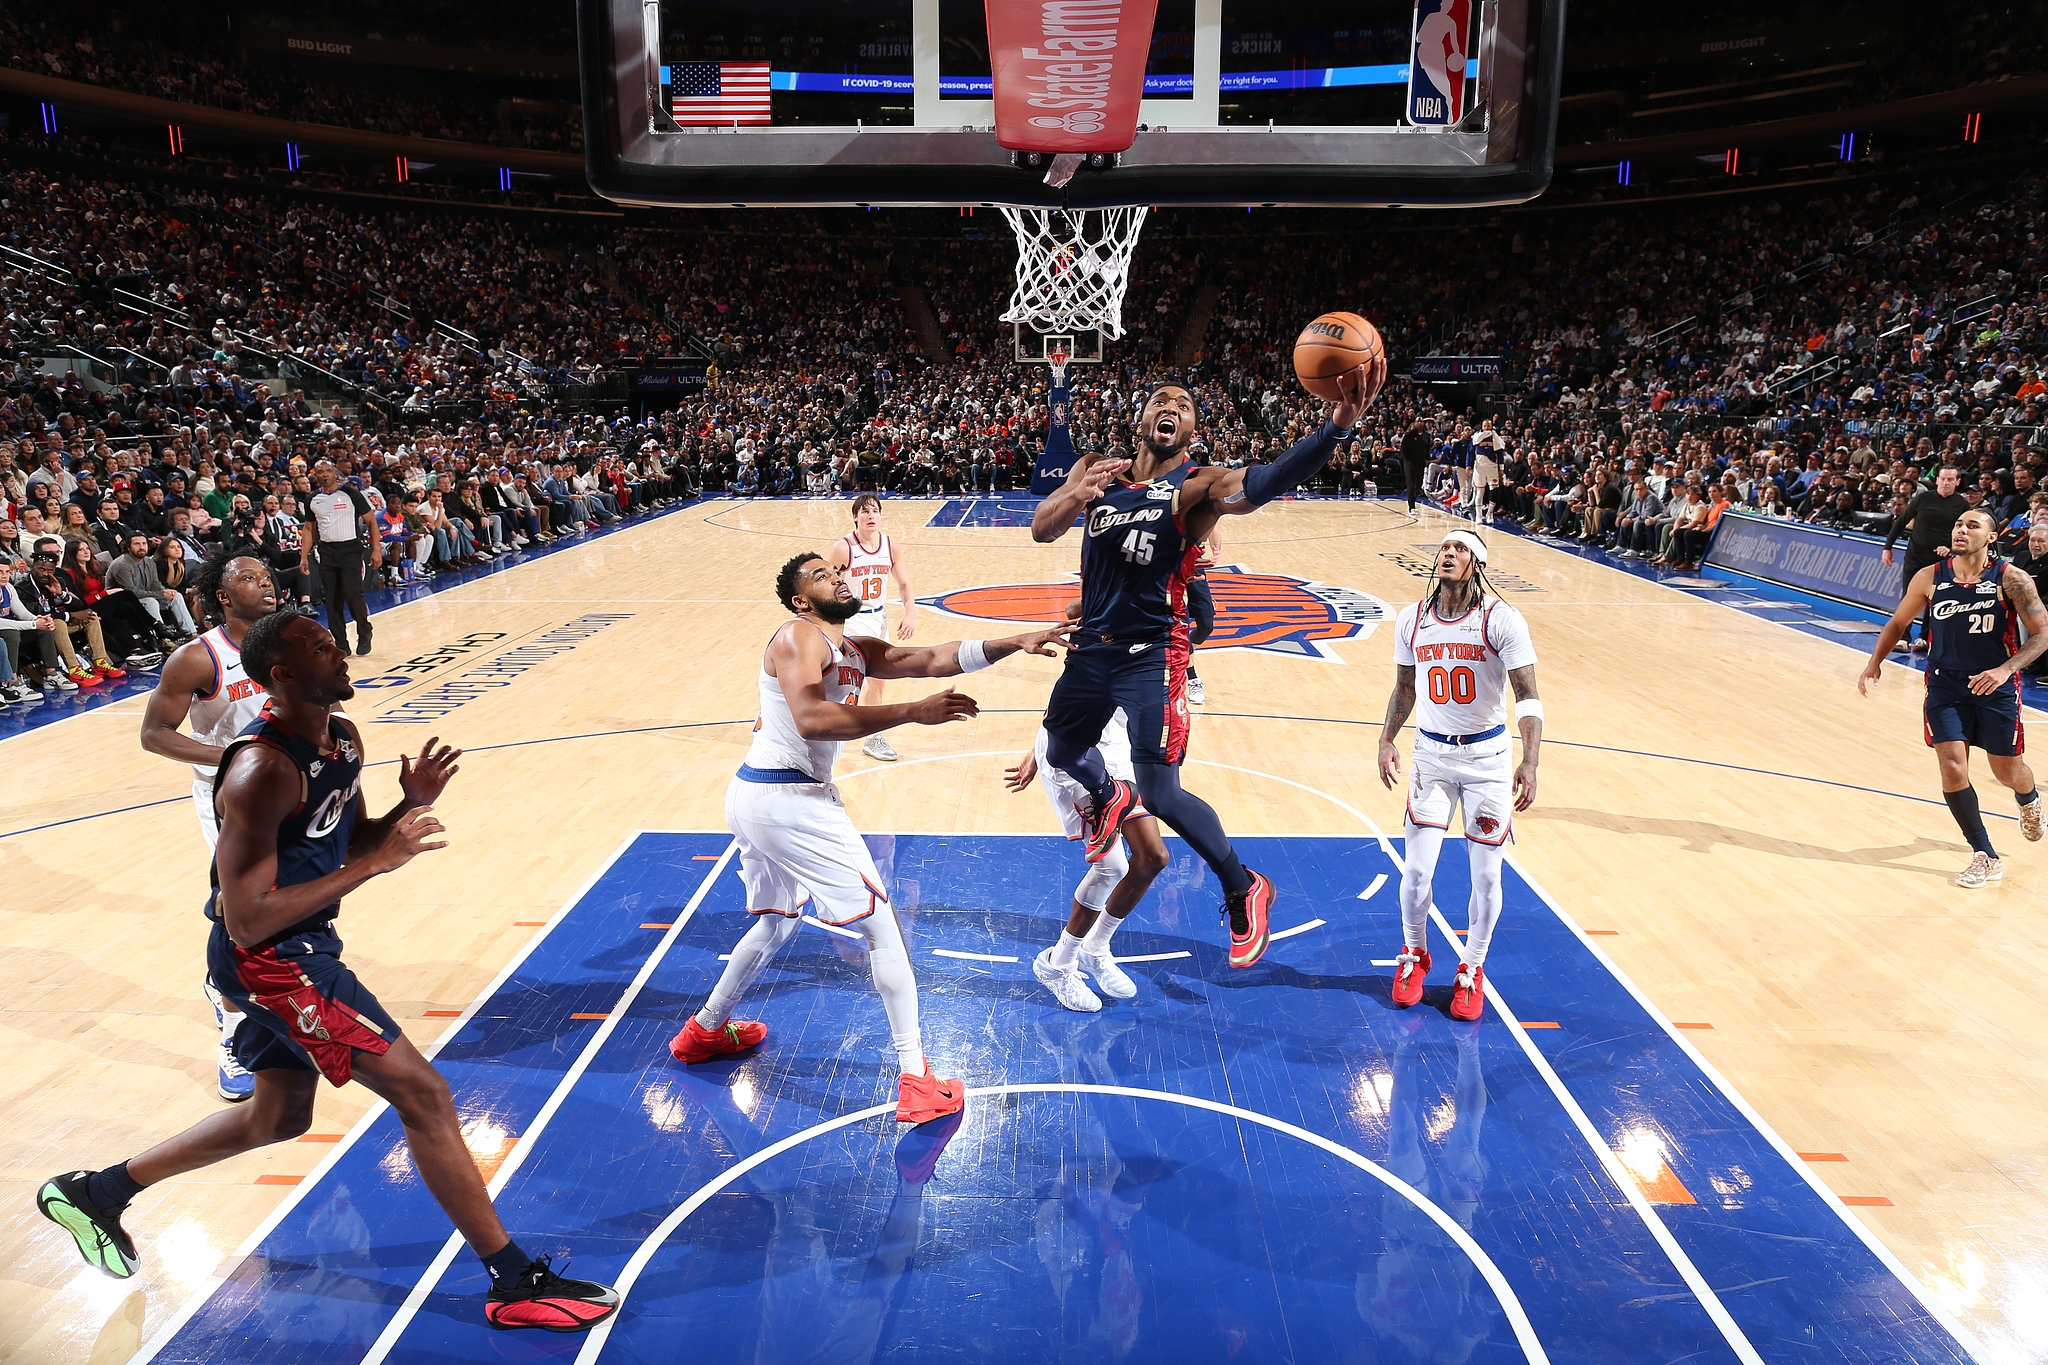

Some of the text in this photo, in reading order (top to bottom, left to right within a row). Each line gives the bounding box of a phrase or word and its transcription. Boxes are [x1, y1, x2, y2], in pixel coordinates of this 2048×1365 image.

[287, 38, 352, 54] BUD LIGHT
[1701, 36, 1766, 52] BUD LIGHT
[842, 78, 850, 87] If
[850, 78, 893, 88] COVID-19
[939, 82, 969, 90] season,
[1144, 79, 1159, 87] Ask
[1159, 80, 1176, 88] your
[1232, 76, 1251, 86] right
[1251, 75, 1262, 84] for
[1262, 77, 1278, 85] you.
[1415, 97, 1442, 118] NBA
[1461, 364, 1500, 374] ULTRA
[678, 376, 707, 384] ULTRA
[1147, 491, 1171, 500] CLIFFS
[1088, 504, 1164, 538] CLEVELAND
[1120, 529, 1158, 566] 45
[851, 565, 871, 577] NEW
[1722, 529, 1904, 597] League Pass STREAM LIKE YOU'RE
[861, 577, 882, 600] 13
[1933, 599, 1996, 621] CLEVELAND
[1968, 613, 1995, 634] 20
[383, 632, 507, 673] CHASE
[1415, 642, 1487, 662] NEW YORK
[226, 678, 266, 703] NEW
[1427, 665, 1477, 705] 00
